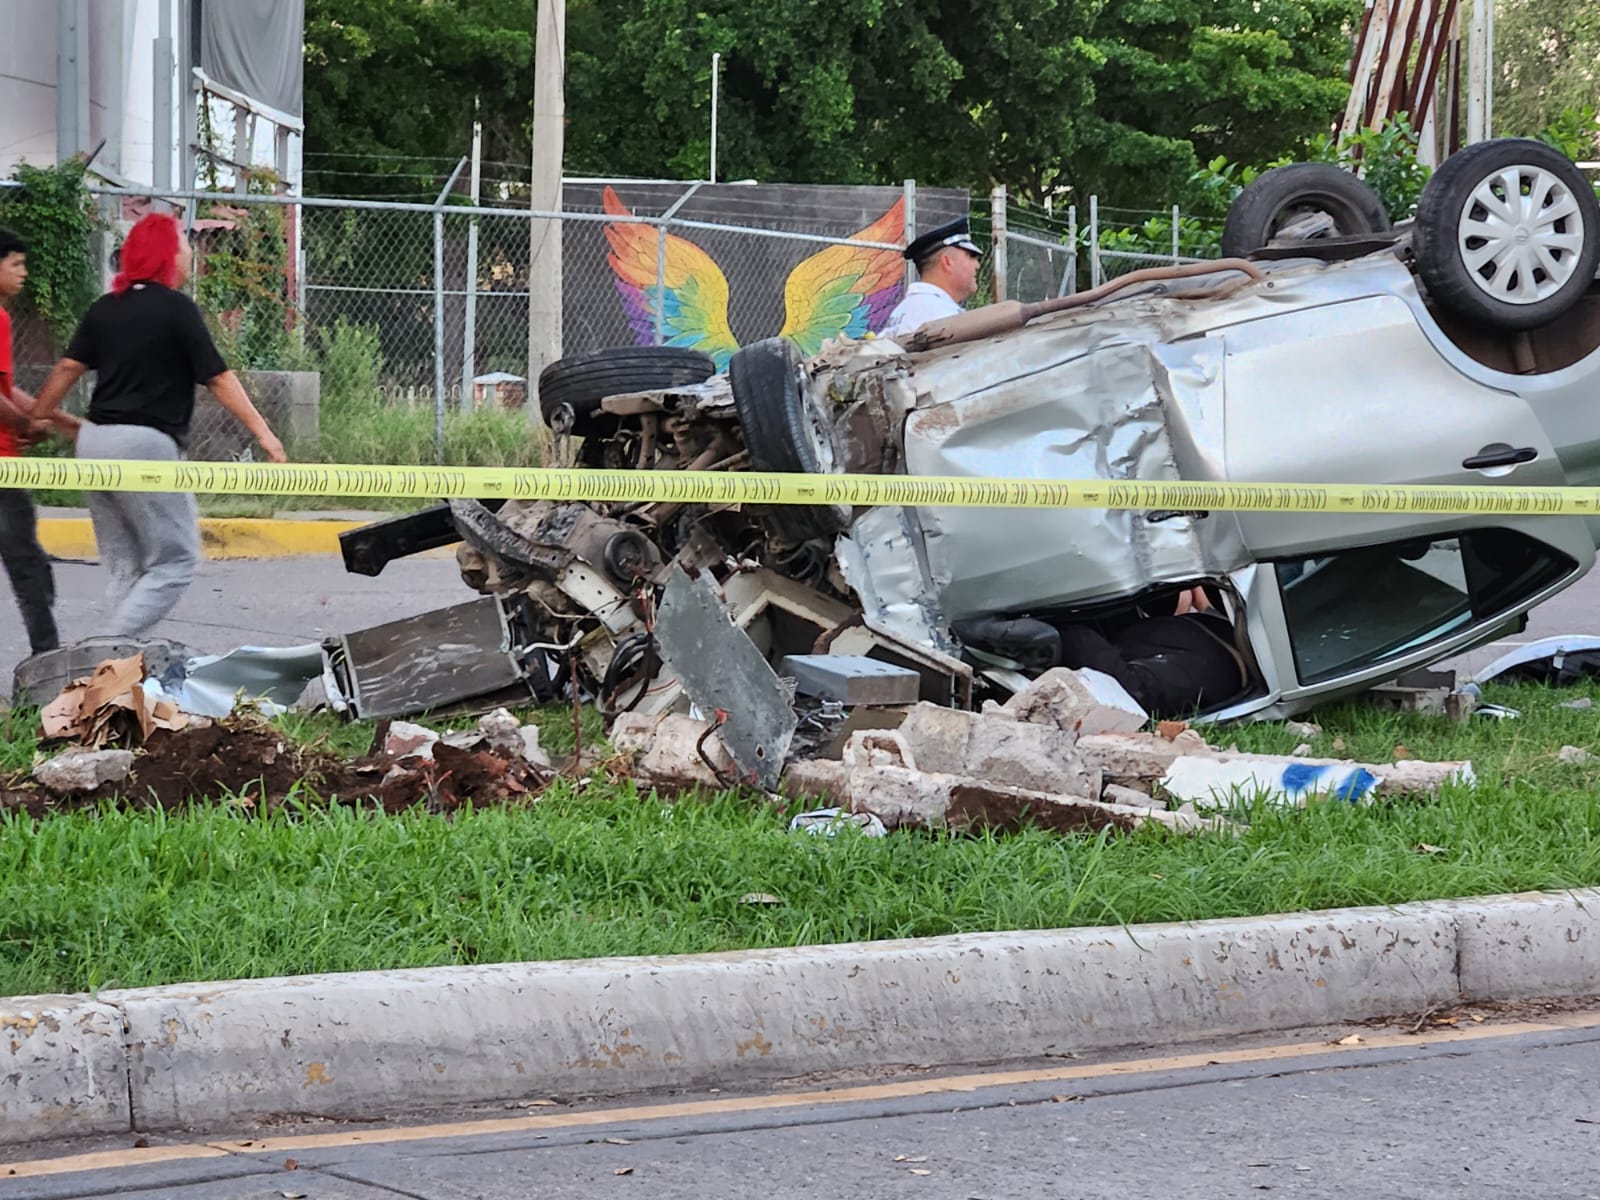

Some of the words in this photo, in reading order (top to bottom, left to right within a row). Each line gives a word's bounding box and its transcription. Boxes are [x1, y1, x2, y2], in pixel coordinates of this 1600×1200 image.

[46, 462, 67, 486] DE
[75, 464, 121, 486] LINEA
[176, 466, 214, 489] PASO
[221, 468, 238, 489] EL
[245, 468, 328, 492] PROHIBIDO
[335, 470, 391, 493] POLICIA
[397, 472, 416, 493] DE
[422, 472, 465, 494] LINEA
[514, 474, 550, 496] PASO
[555, 474, 572, 496] EL
[578, 475, 654, 497] PROHIBIDO
[661, 477, 713, 498] POLICIA
[717, 478, 735, 498] DE
[742, 478, 780, 499] LINEA
[825, 480, 859, 501] PASO
[863, 480, 878, 501] EL
[884, 481, 954, 502] PROHIBIDO
[960, 482, 1007, 503] POLICIA
[1012, 484, 1028, 504] DE
[1033, 484, 1069, 505] LINEA
[1108, 485, 1138, 506] PASO
[1142, 486, 1157, 506] EL
[1162, 486, 1225, 507] PROHIBIDO
[1230, 487, 1272, 507] POLICIA
[1275, 488, 1289, 508] DE
[1295, 488, 1326, 509] LINEA
[1362, 489, 1390, 509] PASO
[1393, 489, 1407, 509] EL
[1411, 490, 1469, 510] PROHIBIDO
[1473, 491, 1512, 510] POLICIA
[1515, 491, 1529, 510] DE
[1532, 492, 1562, 511] LINEA
